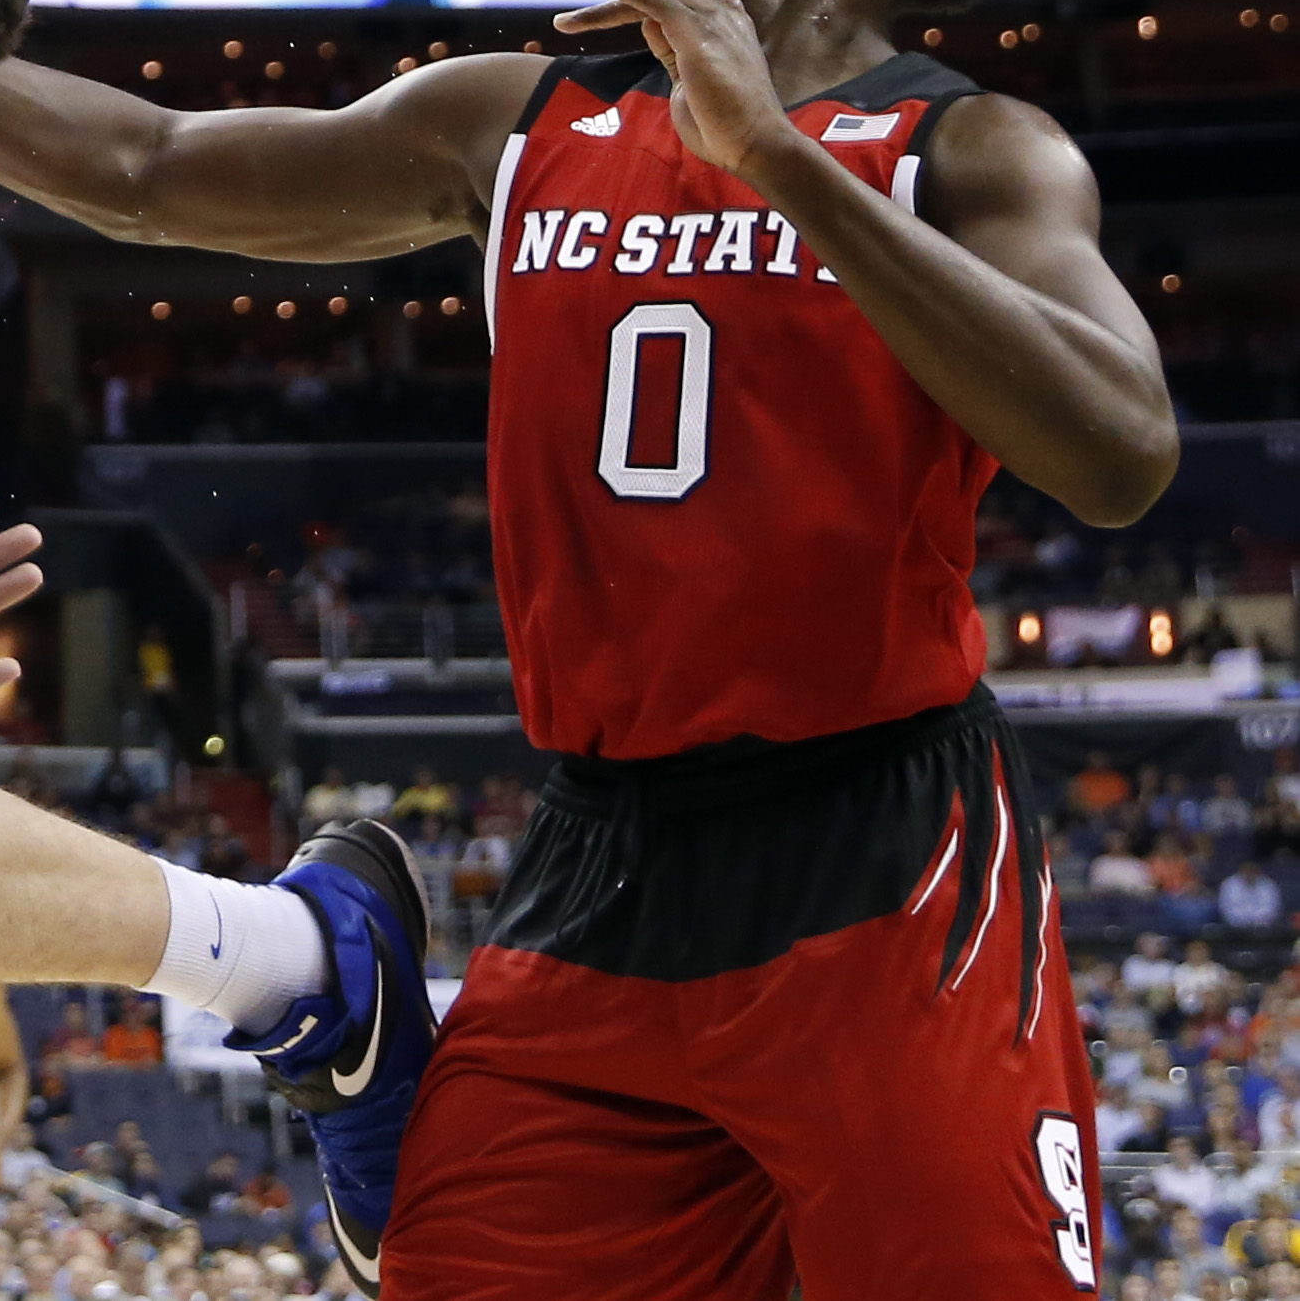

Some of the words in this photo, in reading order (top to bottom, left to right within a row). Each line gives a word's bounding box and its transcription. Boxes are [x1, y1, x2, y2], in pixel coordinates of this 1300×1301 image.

[511, 209, 608, 274] NC
[613, 208, 840, 284] STAT
[597, 302, 712, 500] 0
